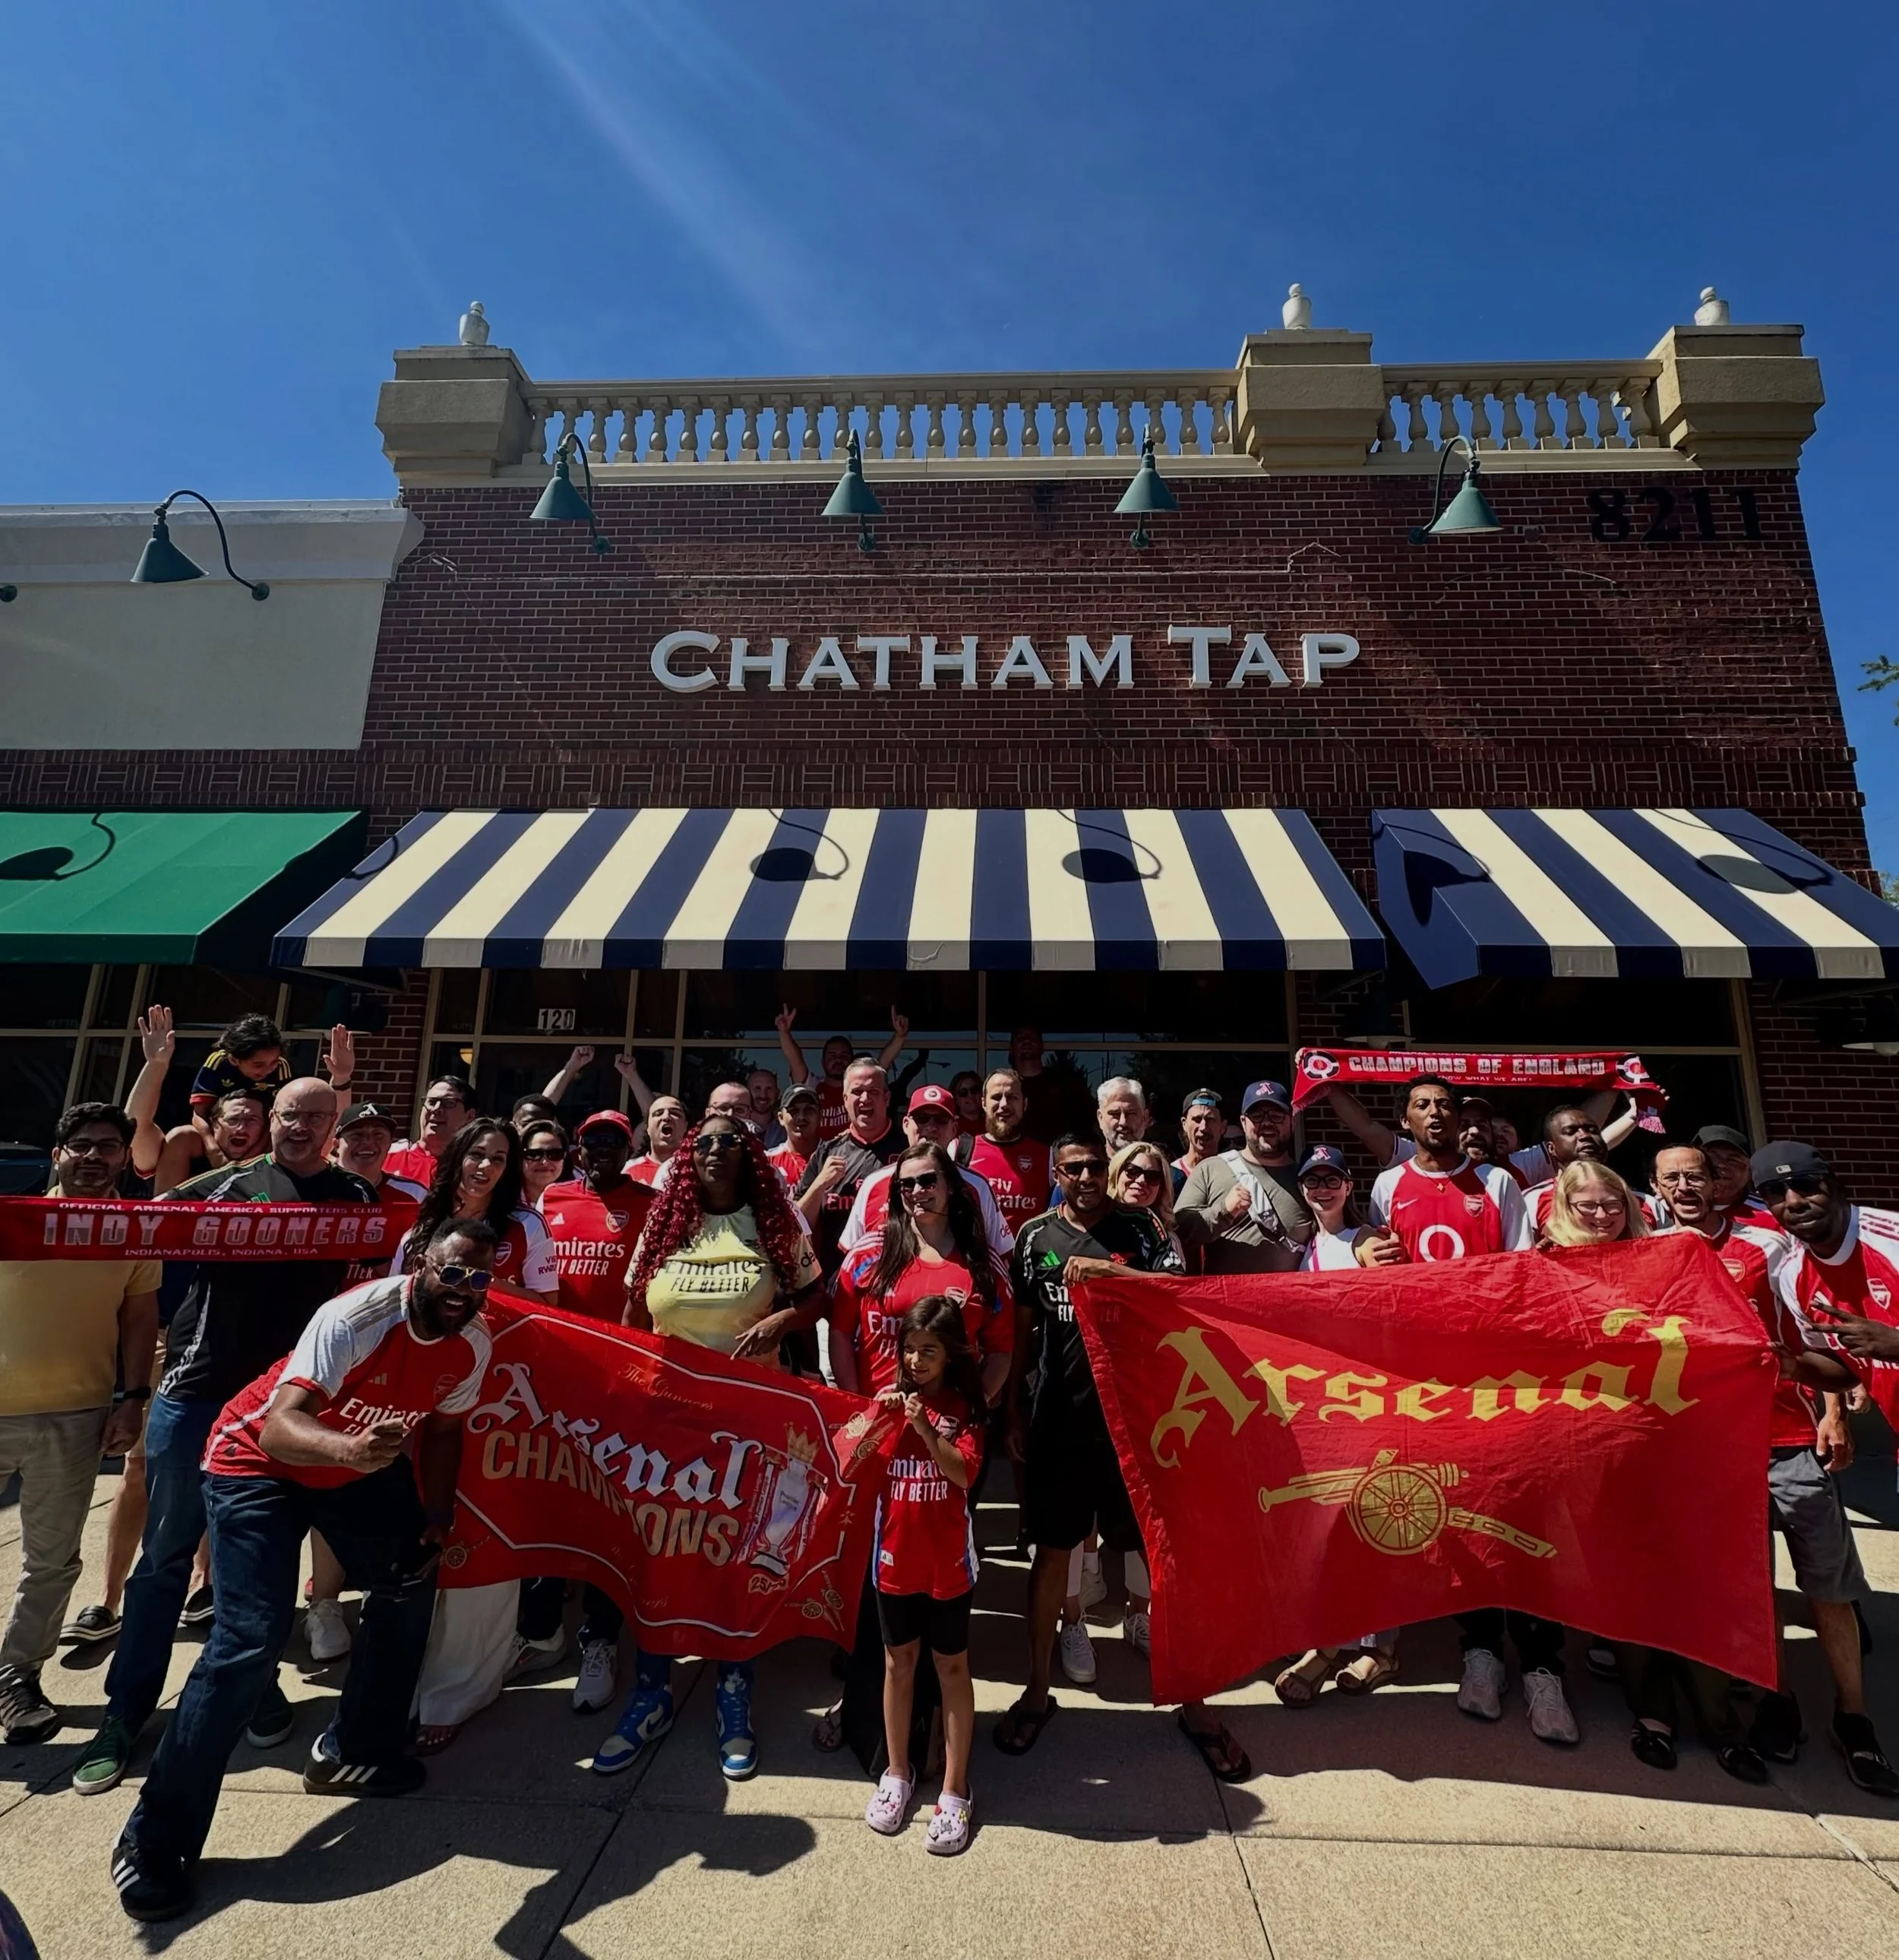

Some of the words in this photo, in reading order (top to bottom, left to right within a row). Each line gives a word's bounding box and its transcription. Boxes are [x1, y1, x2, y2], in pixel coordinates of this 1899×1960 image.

[1587, 487, 1768, 542] 8211
[650, 631, 1134, 693] CHATHAM
[1168, 624, 1360, 688] TAP
[540, 1010, 574, 1029] 120
[1348, 1057, 1467, 1073] CHAMPIONS
[1477, 1058, 1502, 1073] OF
[1513, 1057, 1605, 1075] ENGLAND
[59, 1203, 125, 1211] OFFICIAL
[997, 1192, 1037, 1209] rates
[43, 1213, 164, 1245] INDY
[192, 1216, 387, 1246] GOONERS
[554, 1237, 626, 1258] mirates
[568, 1259, 609, 1276] BETTER
[664, 1259, 763, 1276] Emirates
[671, 1277, 697, 1292] FLY
[699, 1277, 749, 1292] BETTER
[1149, 1308, 1701, 1469] Arsenal
[467, 1363, 763, 1510] Arsenal
[891, 1481, 905, 1501] FLY
[908, 1481, 948, 1502] BETTER
